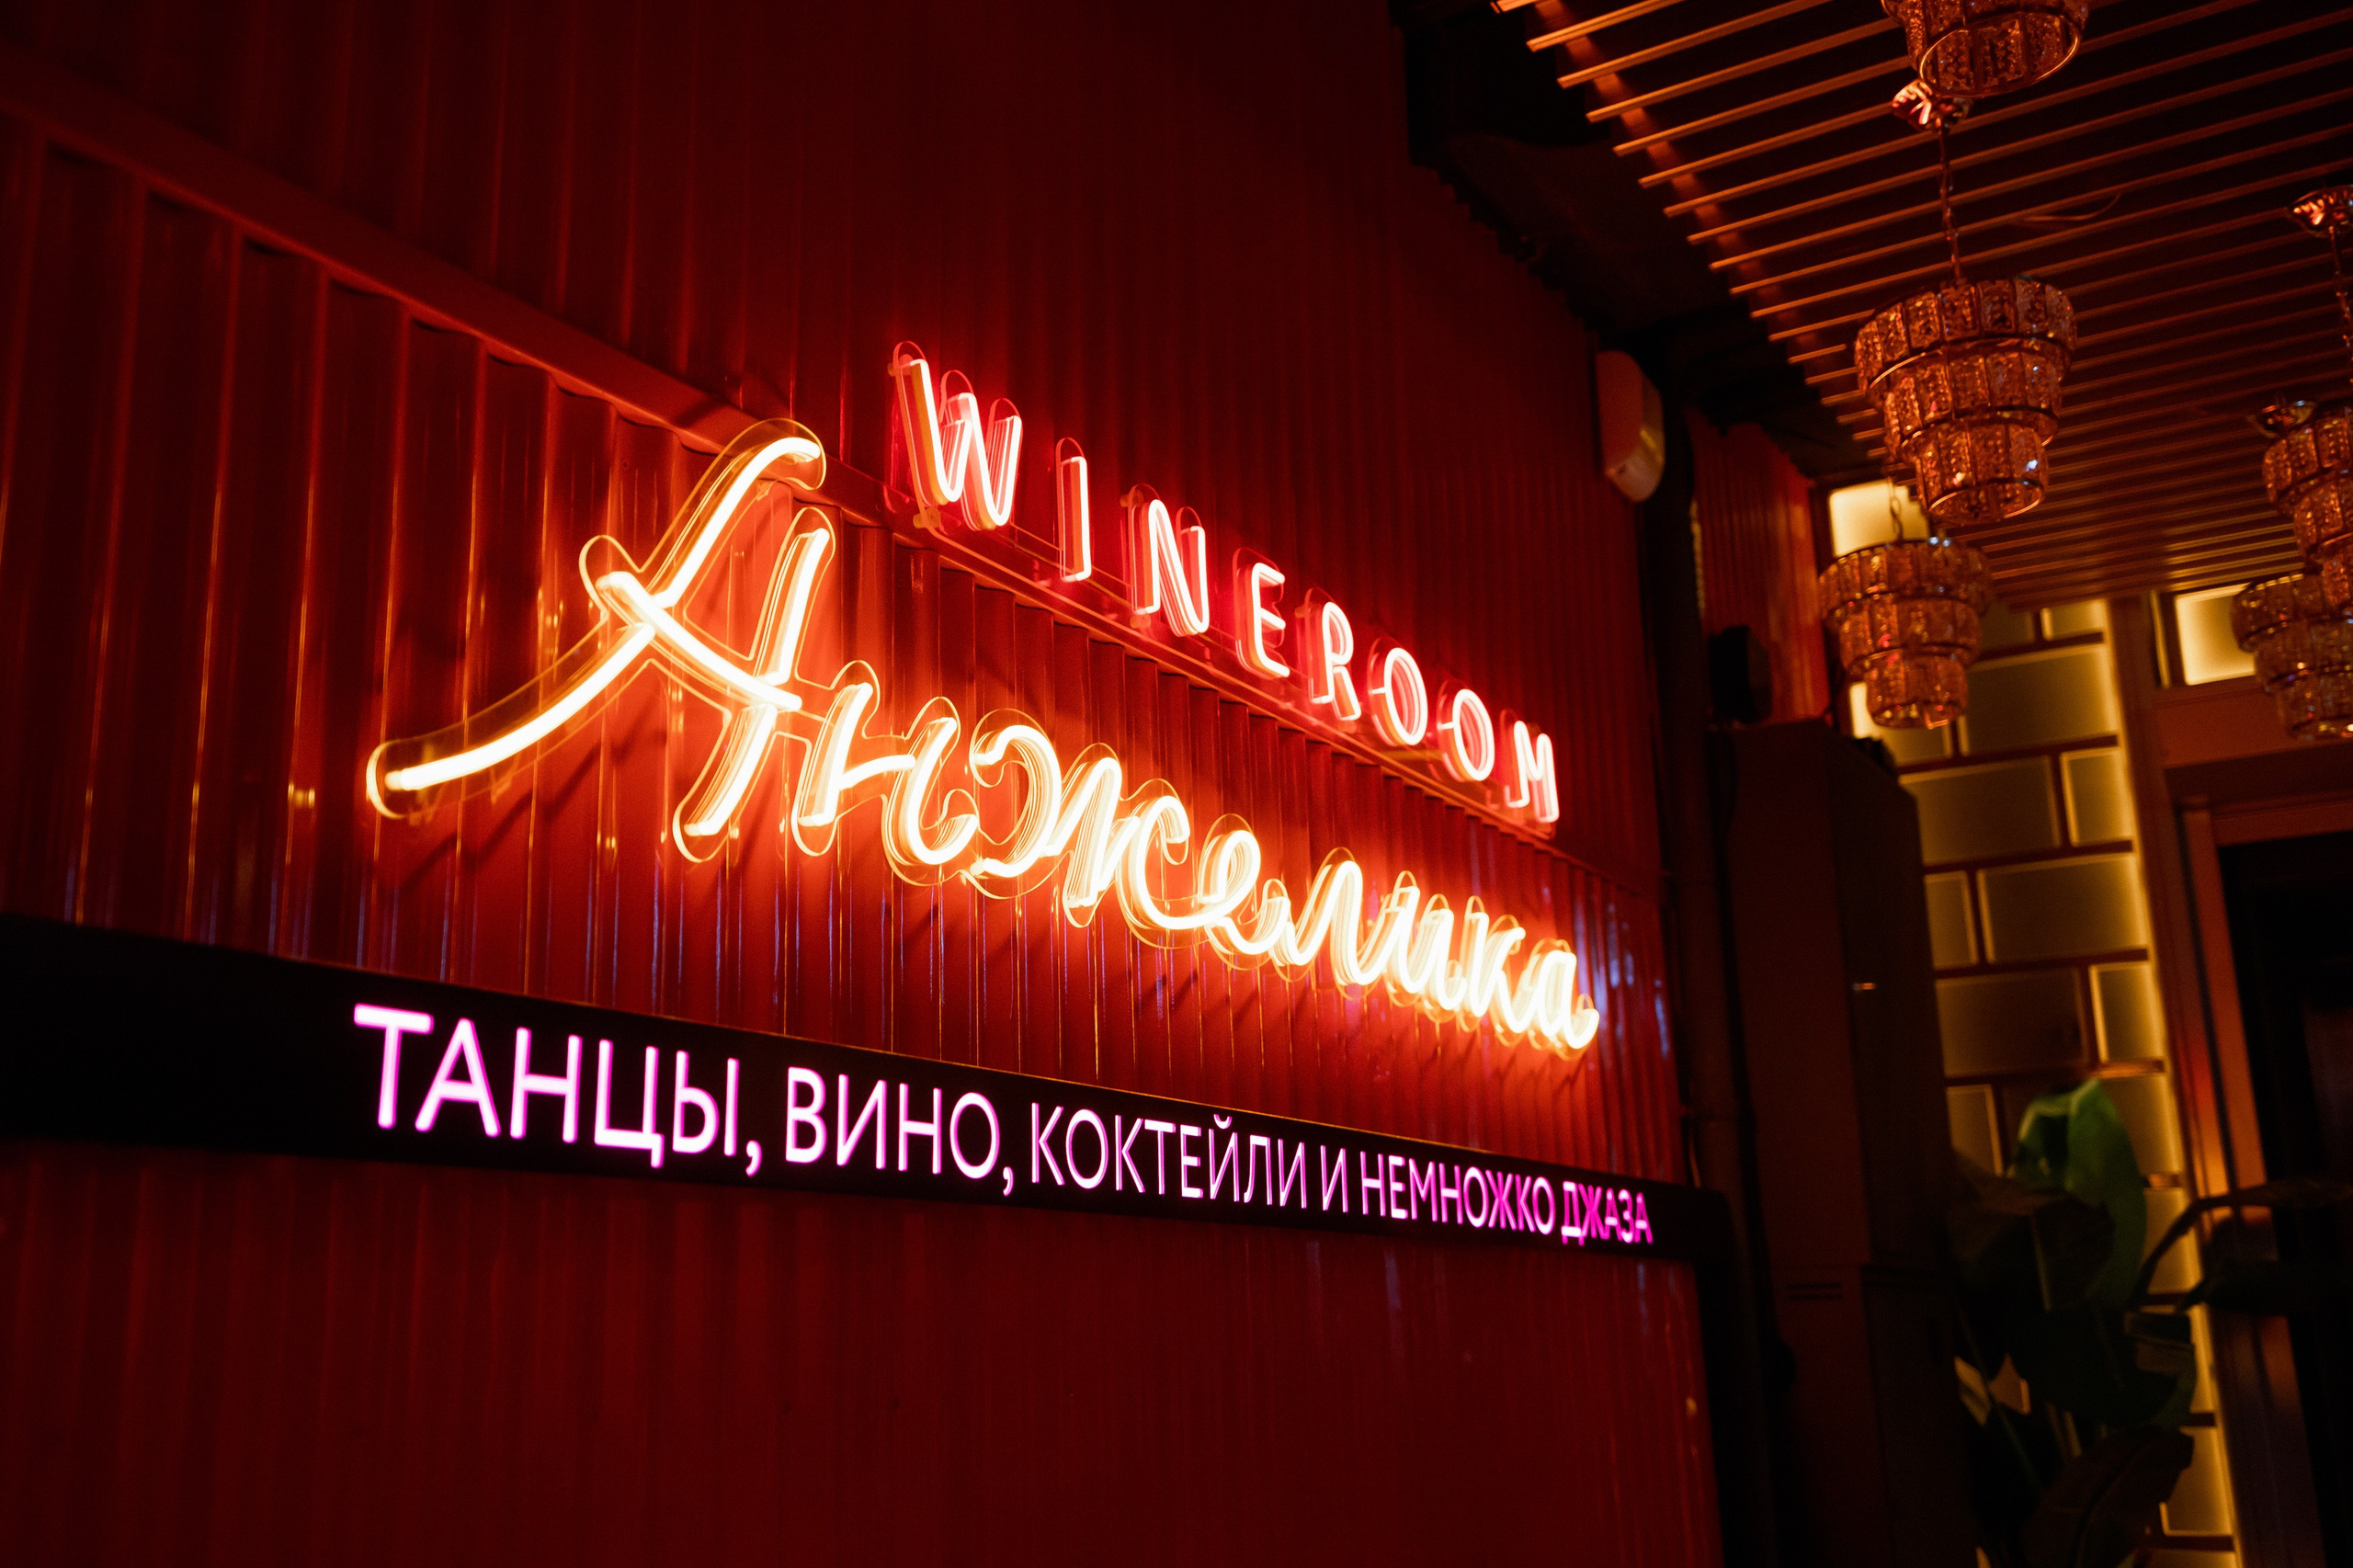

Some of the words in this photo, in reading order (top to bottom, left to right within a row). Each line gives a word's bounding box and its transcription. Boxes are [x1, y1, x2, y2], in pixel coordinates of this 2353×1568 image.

[373, 430, 1601, 1053] Анжелика
[895, 355, 1561, 824] WINEROOM
[352, 1002, 764, 1178] ТАНЦЫ,
[784, 1065, 1016, 1198] ВИНО,
[1030, 1101, 1309, 1210] КОКТЕЙЛИ
[1319, 1143, 1350, 1214] И
[1358, 1150, 1557, 1236] НЕМНОЖКО
[1559, 1179, 1654, 1247] ДЖАЗА
